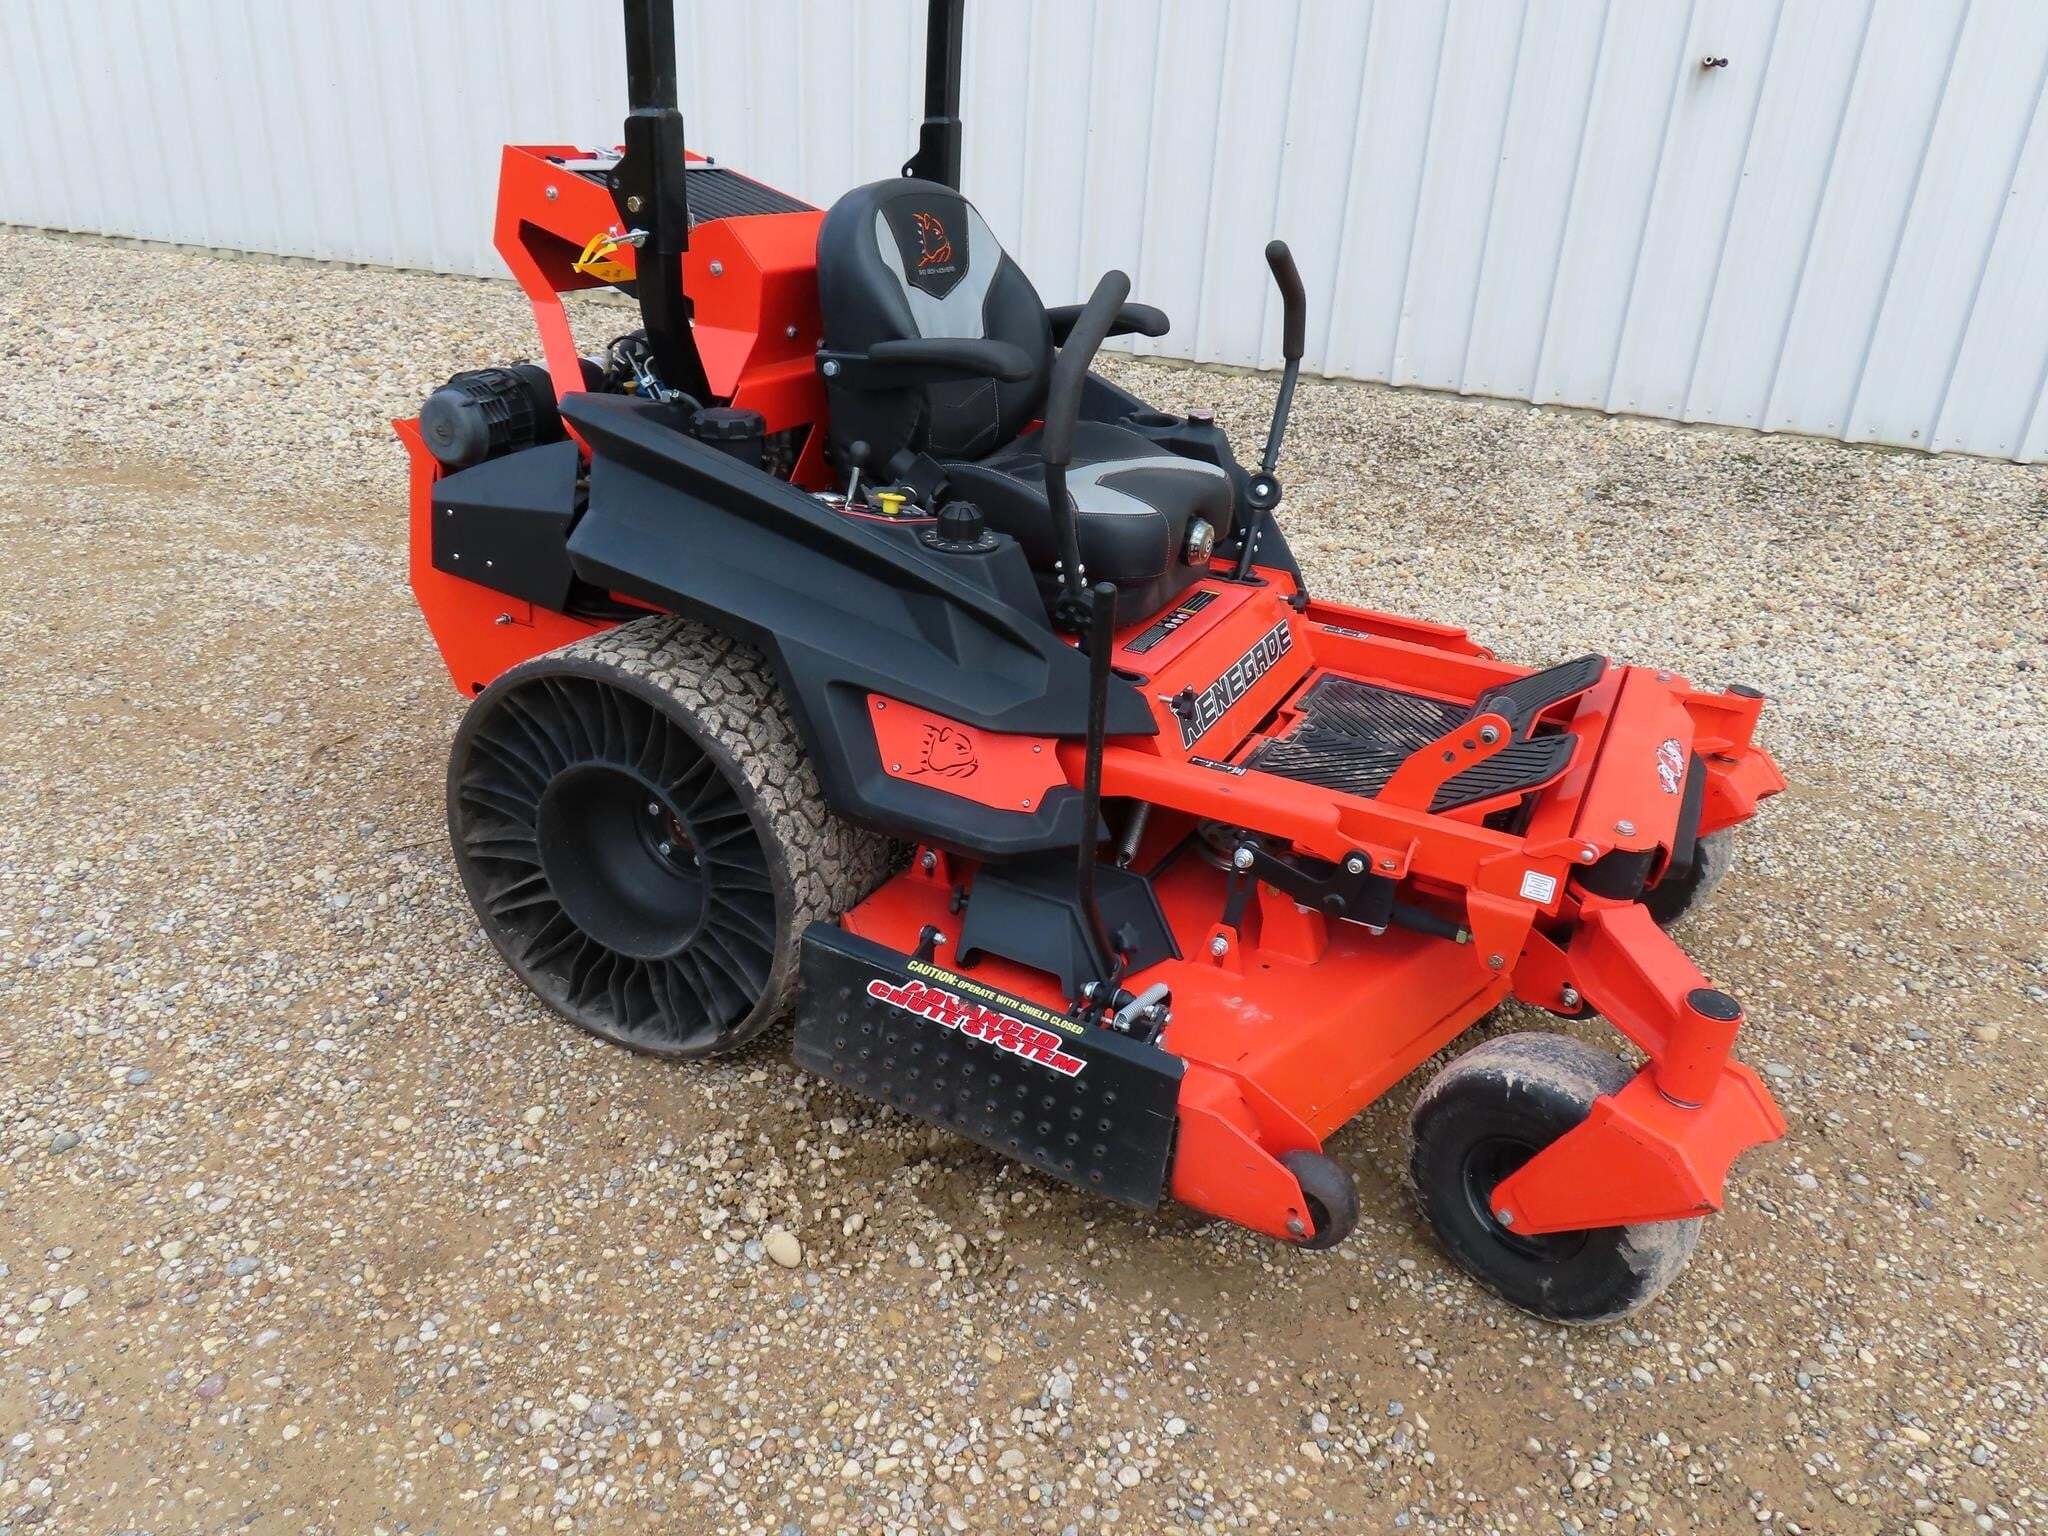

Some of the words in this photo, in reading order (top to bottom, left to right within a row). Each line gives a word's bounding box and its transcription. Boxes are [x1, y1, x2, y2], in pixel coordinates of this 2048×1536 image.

[867, 980, 961, 1029] CHUTE
[960, 1015, 1087, 1077] SYSTEM
[907, 960, 958, 986] CAUTION:
[957, 980, 996, 1001] OPERATE
[996, 995, 1019, 1009] WITH
[1019, 1003, 1050, 1021] SHIELD
[1050, 1016, 1084, 1035] CLOSED
